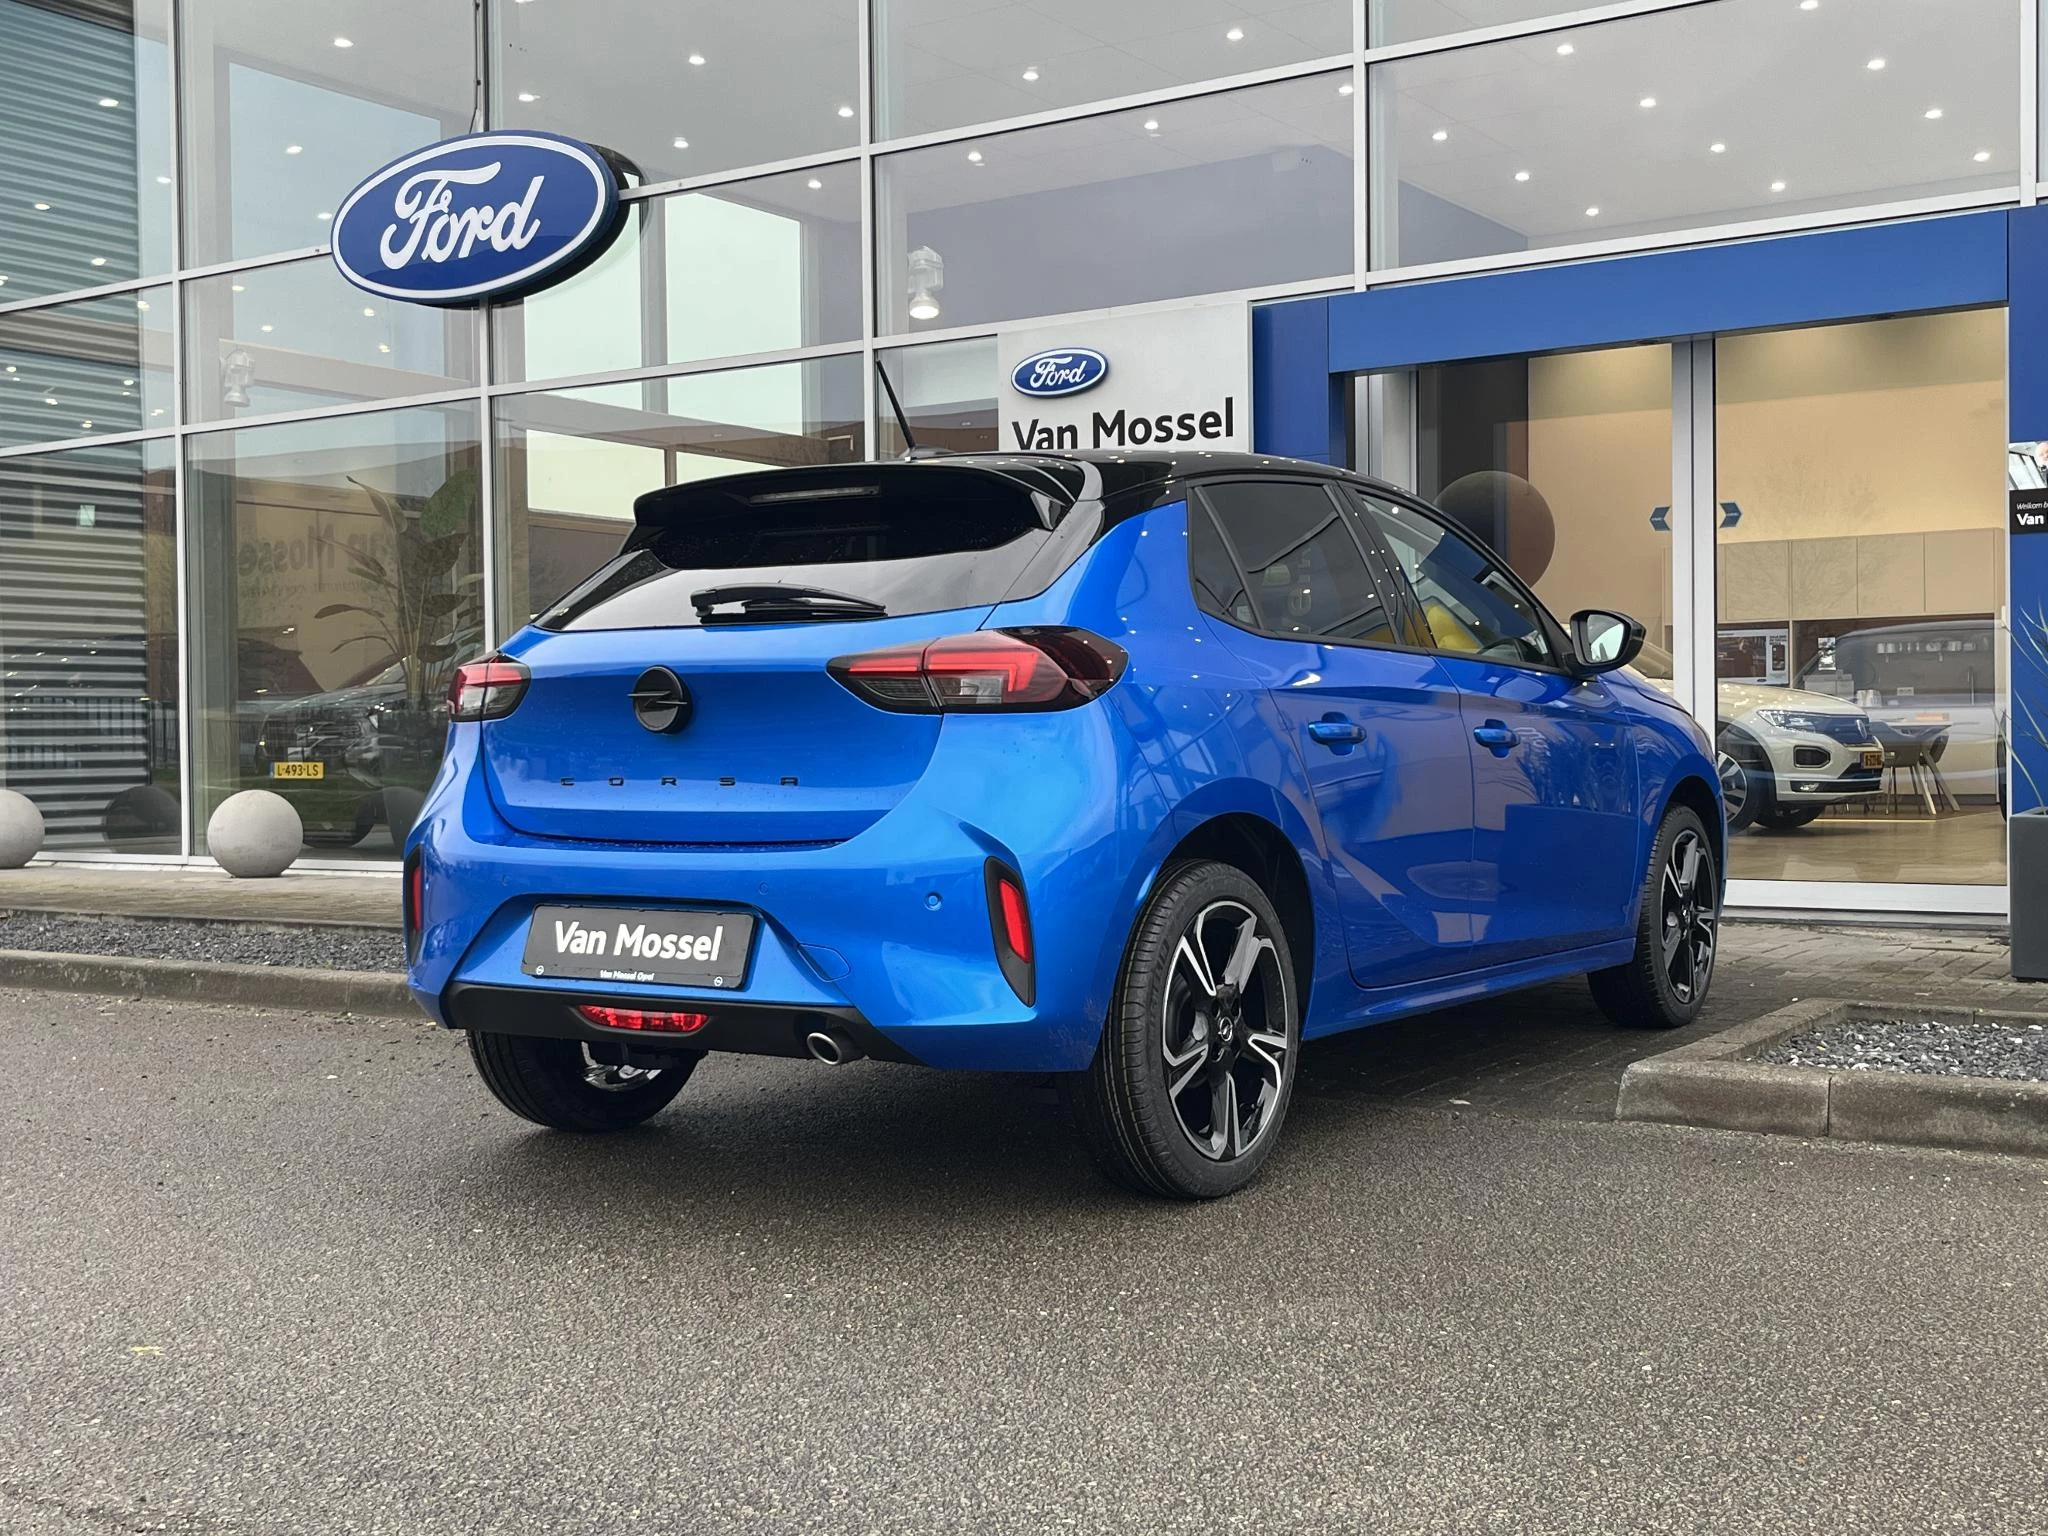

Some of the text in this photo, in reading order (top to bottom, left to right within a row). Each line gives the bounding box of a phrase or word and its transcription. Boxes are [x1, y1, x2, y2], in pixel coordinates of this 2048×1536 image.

[380, 161, 545, 270] Ford
[1029, 356, 1087, 388] Ford
[1012, 397, 1234, 450] Van Mossel
[2016, 513, 2044, 526] Van
[560, 777, 799, 787] CORSA
[555, 920, 723, 961] Van Mossel
